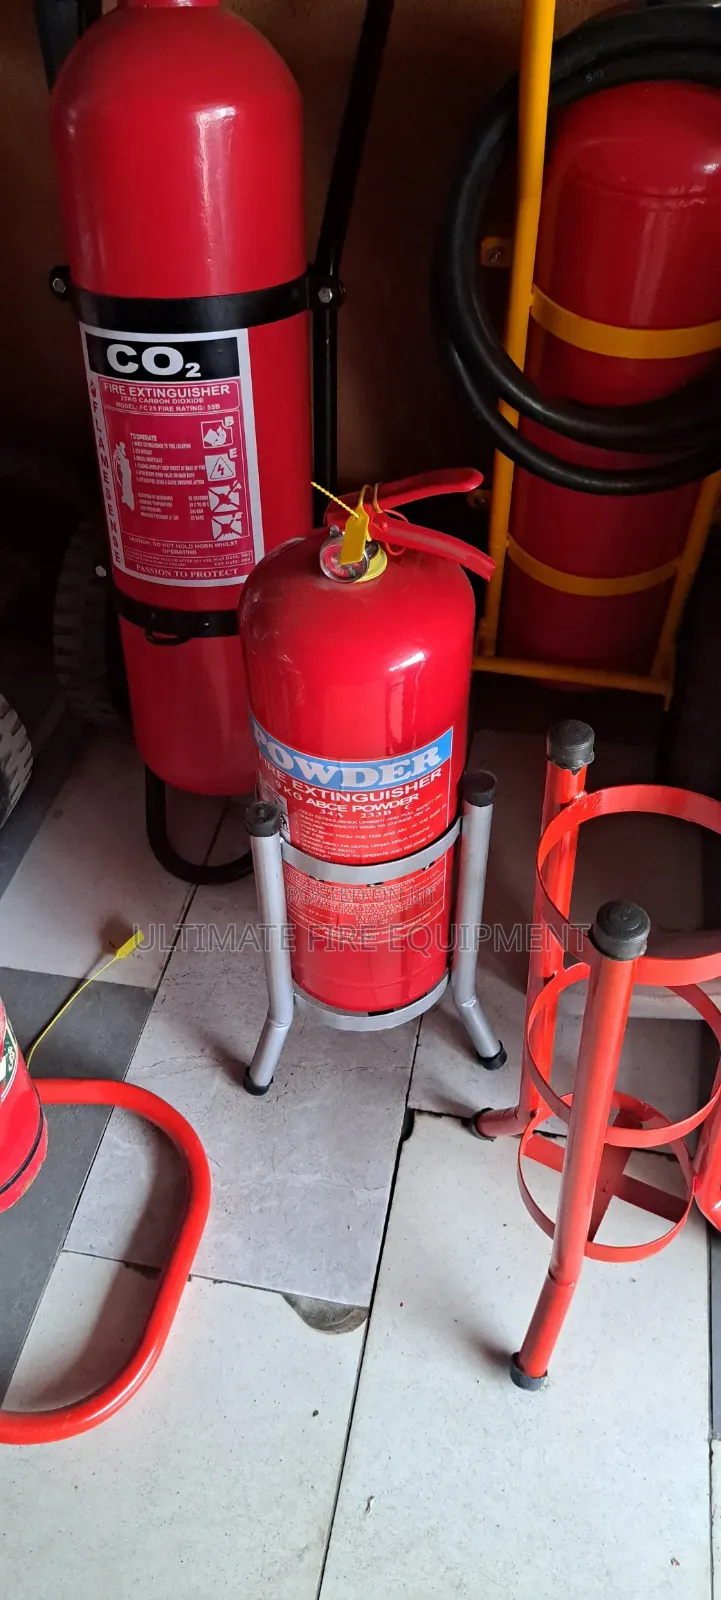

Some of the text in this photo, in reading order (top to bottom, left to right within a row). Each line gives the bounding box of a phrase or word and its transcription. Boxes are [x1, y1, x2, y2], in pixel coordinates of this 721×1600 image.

[104, 382, 230, 398] FIRE EXTINGUISHER
[120, 395, 137, 403] 25KG
[116, 402, 138, 411] MODEL:
[176, 404, 205, 412] RATING:
[224, 416, 234, 427] B
[229, 447, 238, 458] E
[93, 401, 121, 563] FLAMESENSE
[214, 540, 238, 548] WHILST
[136, 564, 172, 576] PASSION
[190, 568, 239, 578] PROTECT
[253, 719, 442, 788] POWDER
[292, 768, 442, 802] EXTINGUISHER
[284, 785, 302, 800] KG
[306, 798, 348, 812] ABCE
[352, 793, 420, 812] POWDER
[361, 809, 392, 818] 233B
